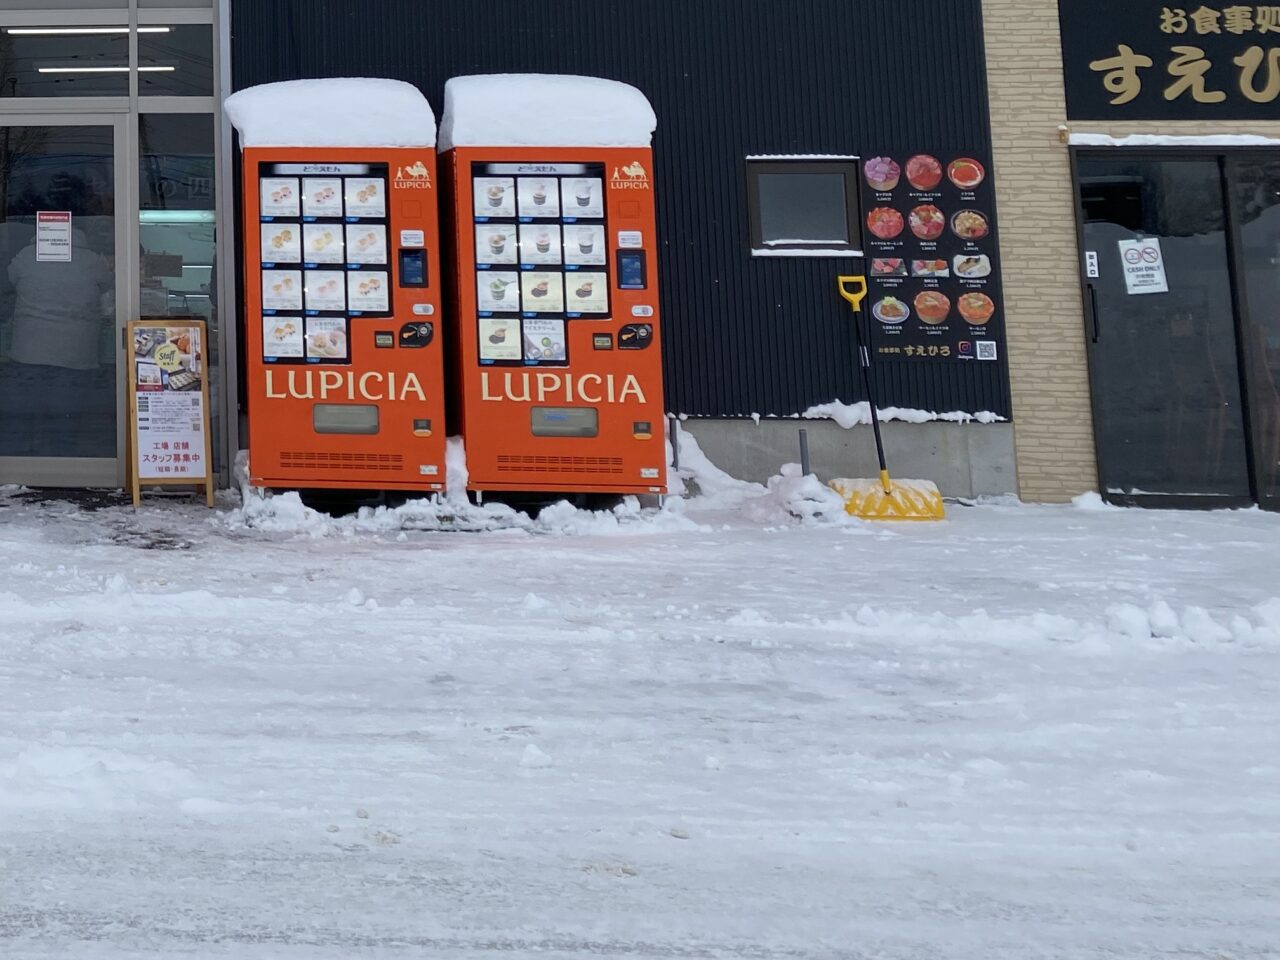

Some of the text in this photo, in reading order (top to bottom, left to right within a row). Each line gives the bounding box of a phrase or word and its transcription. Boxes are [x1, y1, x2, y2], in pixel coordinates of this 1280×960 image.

[394, 181, 432, 189] LUPICIA
[610, 181, 650, 190] LUPICIA
[159, 350, 176, 361] Staff
[904, 345, 951, 357] すえひろ
[263, 369, 427, 401] LUPICIA
[480, 371, 646, 404] LUPICIA
[143, 453, 201, 463] スタッフ募集中
